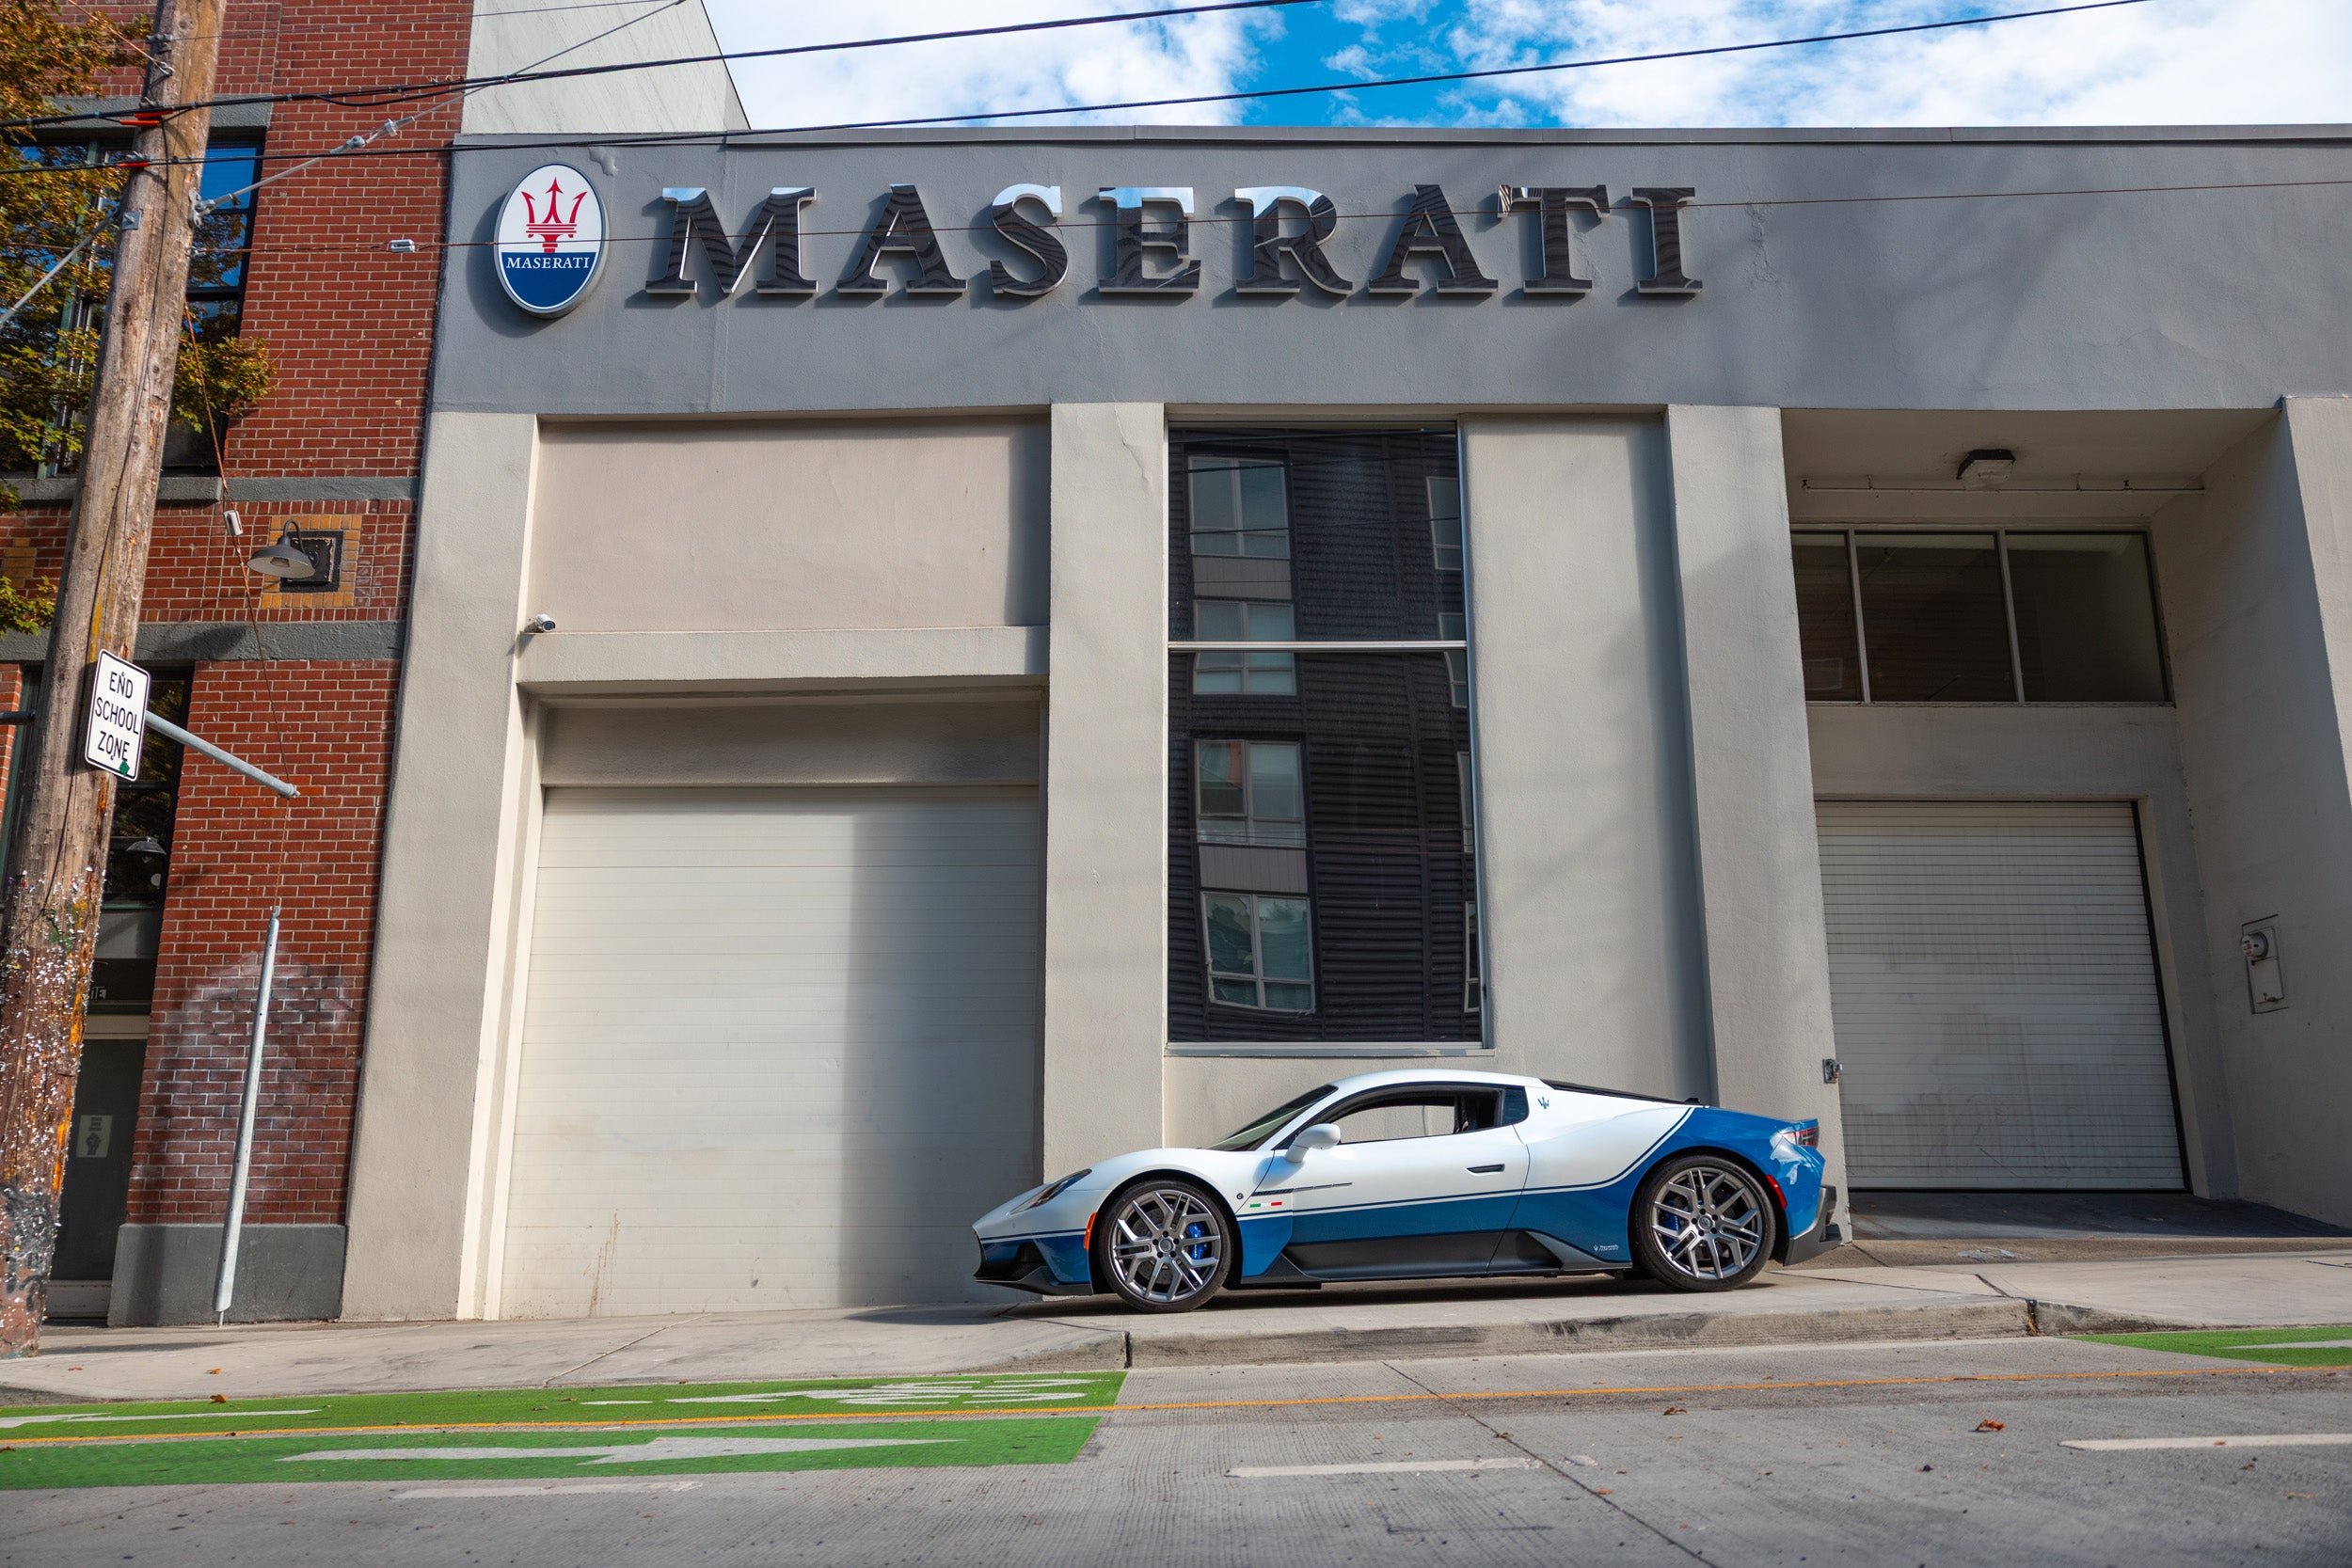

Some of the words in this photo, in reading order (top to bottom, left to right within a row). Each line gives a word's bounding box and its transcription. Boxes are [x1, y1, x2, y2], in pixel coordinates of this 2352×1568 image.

[645, 183, 1703, 294] MASERATI
[506, 257, 590, 269] MASERATI
[109, 671, 134, 699] END
[95, 696, 139, 735] SCHOOL
[98, 730, 130, 762] ZONE
